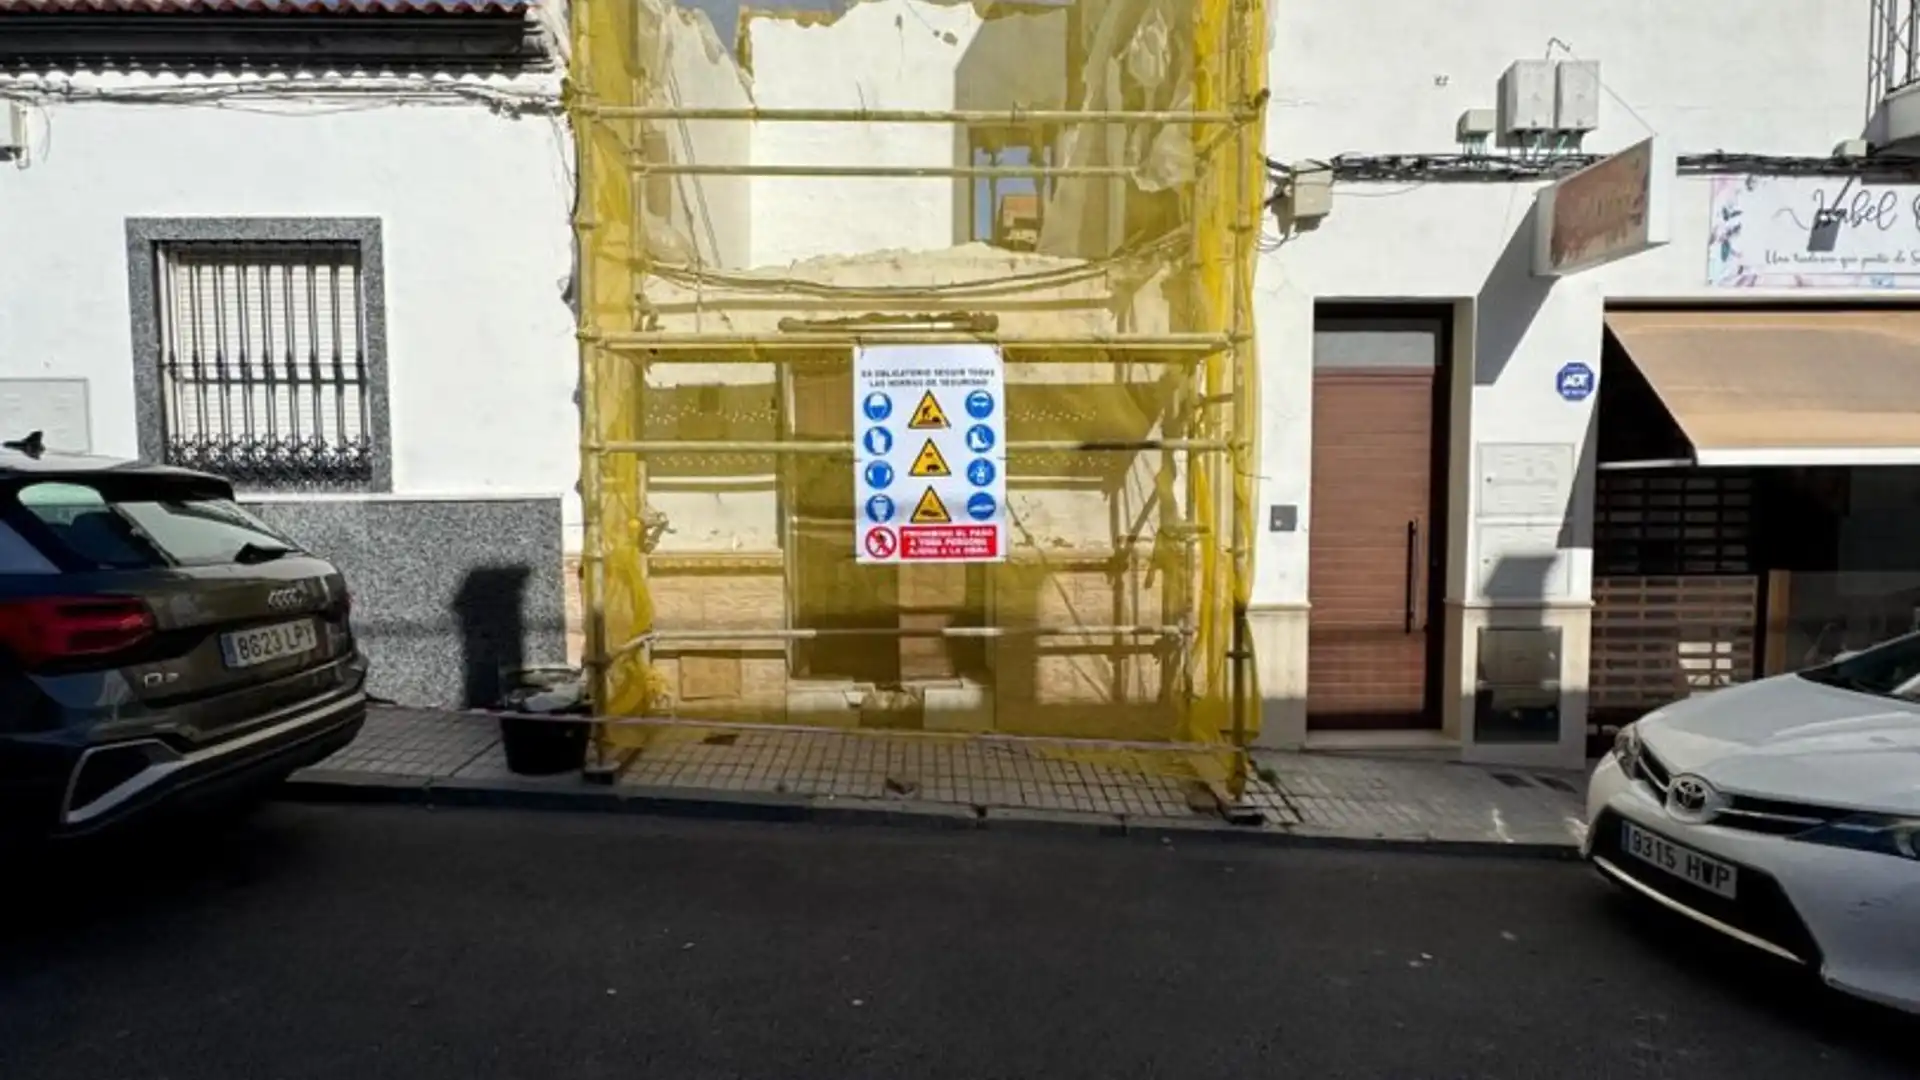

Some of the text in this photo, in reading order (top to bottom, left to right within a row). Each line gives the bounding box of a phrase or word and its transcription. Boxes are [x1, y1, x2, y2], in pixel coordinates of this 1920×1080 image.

[875, 368, 931, 378] OBLIGATORIO
[934, 368, 966, 377] SEGUIR
[940, 378, 988, 387] SEGURIDAD
[903, 529, 954, 538] PROHIBIDO
[969, 528, 994, 537] PASO
[945, 537, 987, 546] PERSONA
[963, 546, 989, 555] OBRA
[237, 628, 283, 660] 8623
[1632, 829, 1677, 870] 9315
